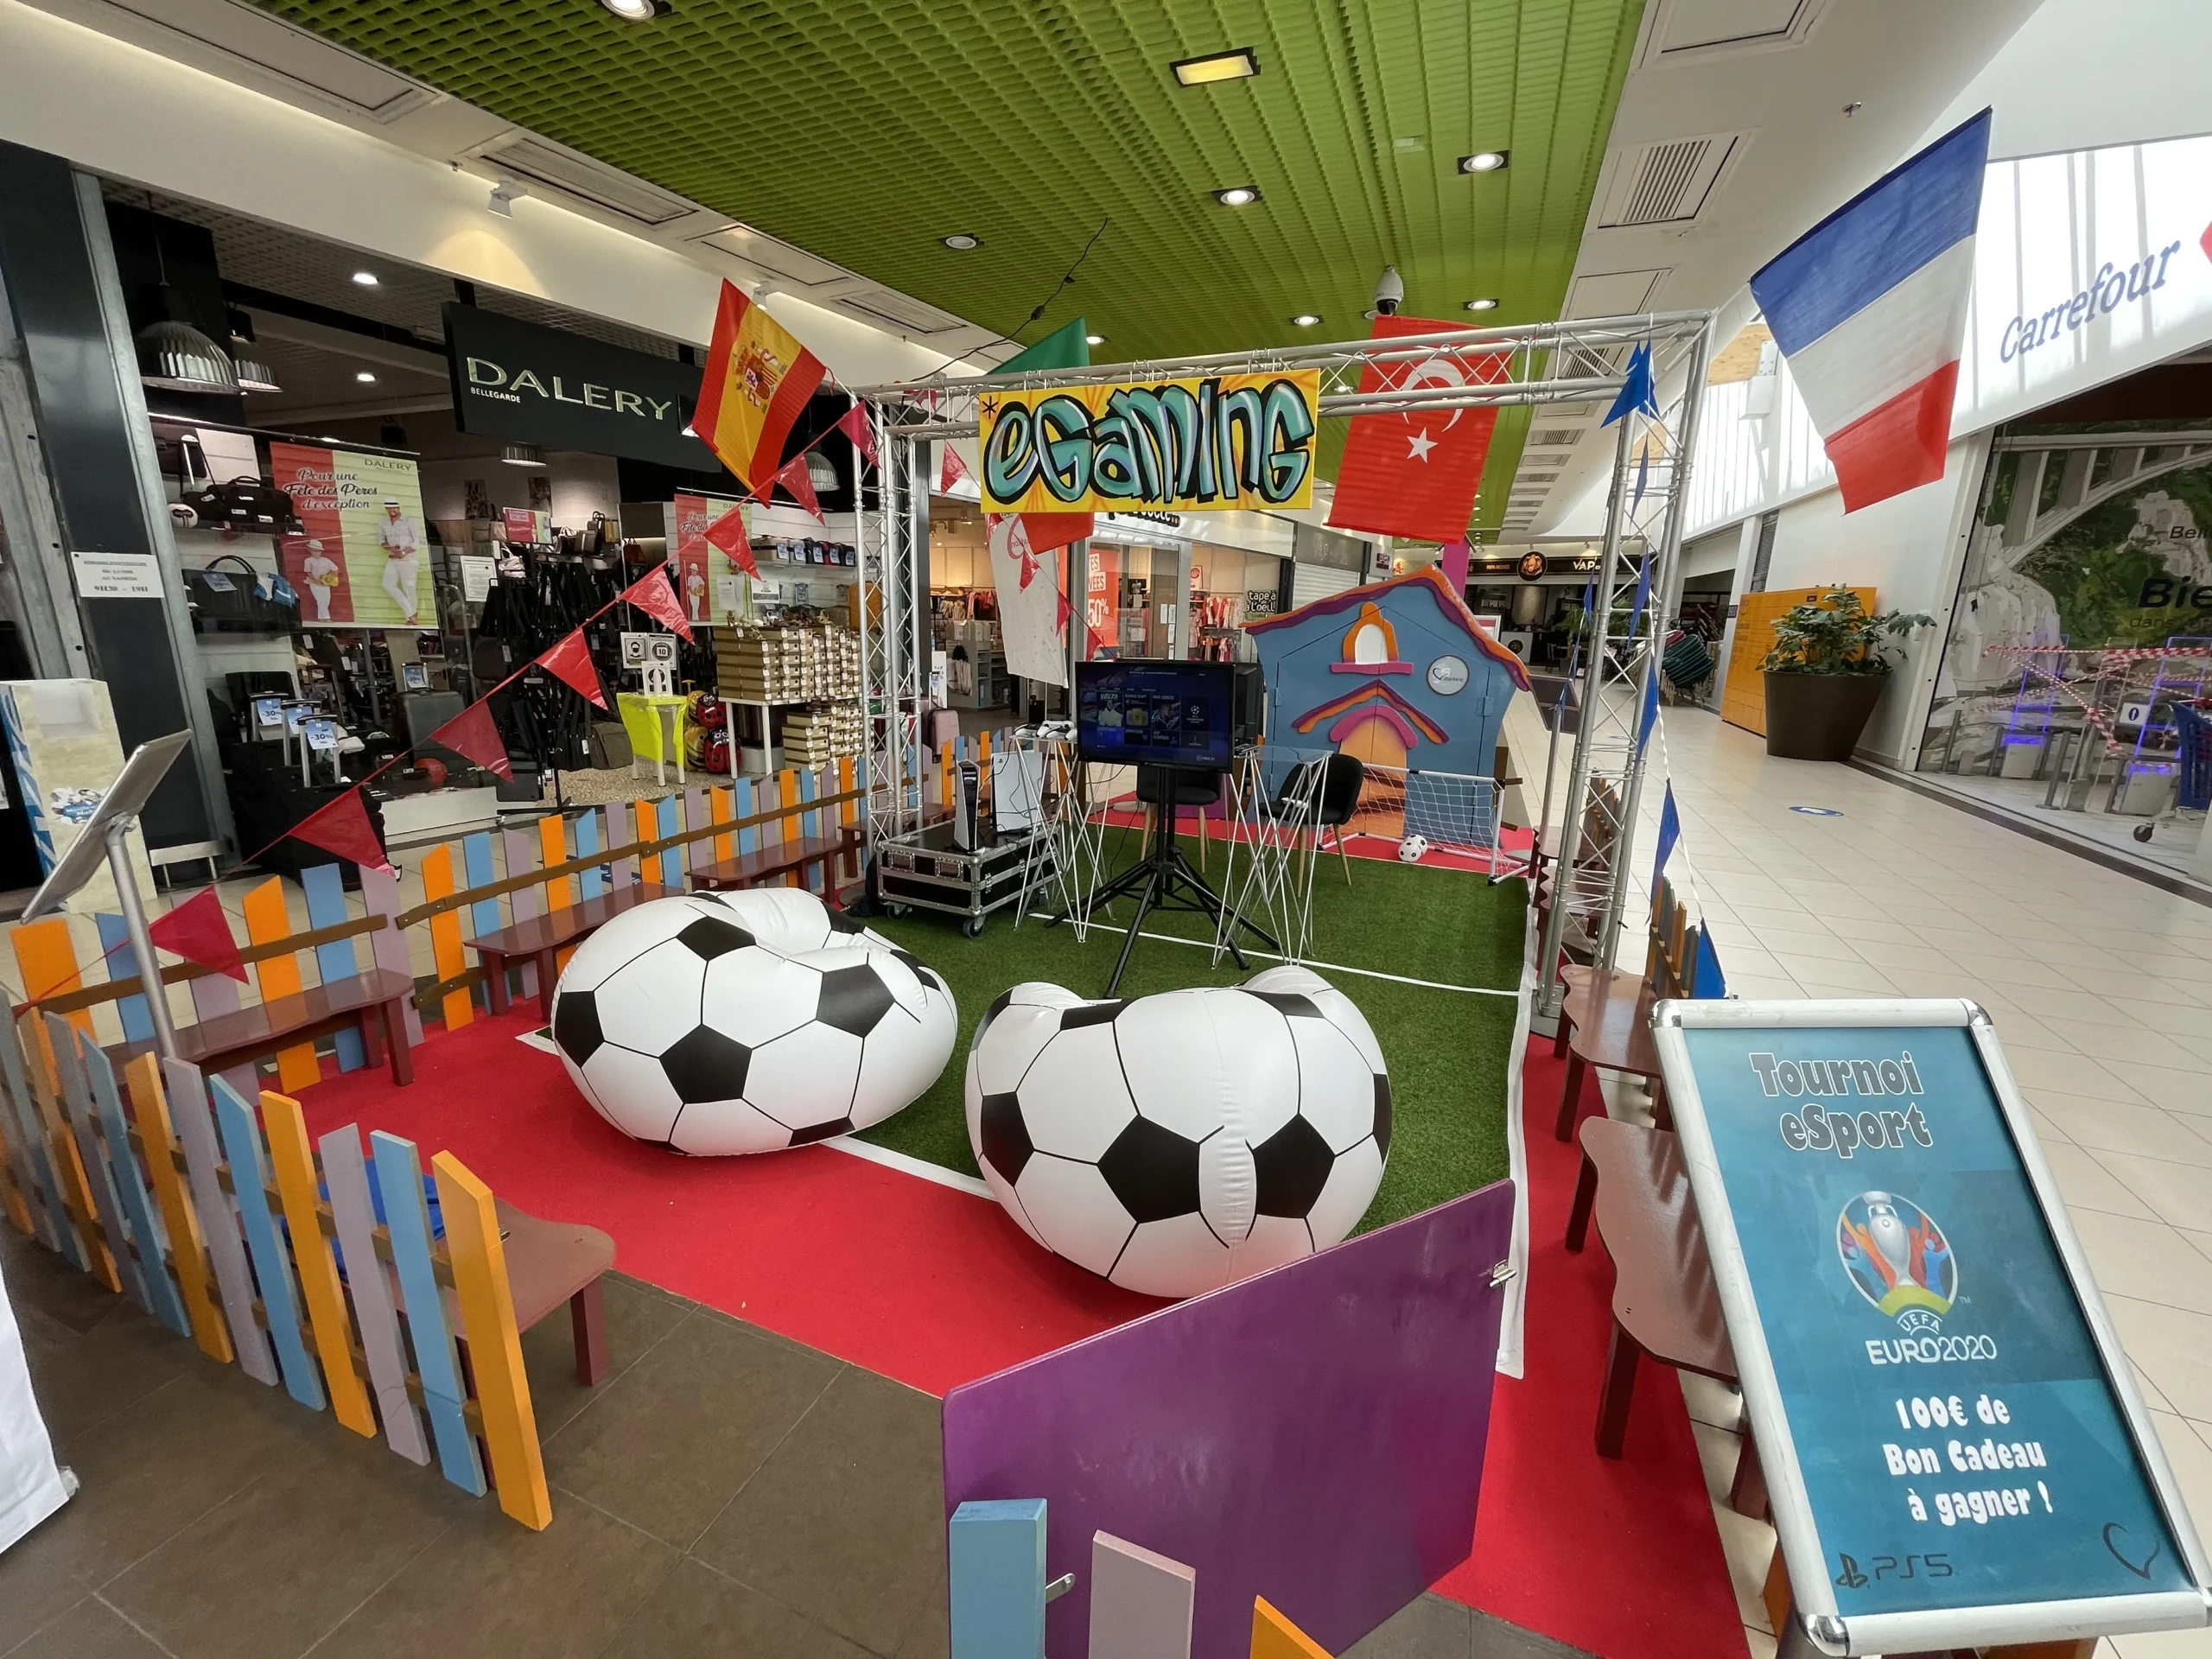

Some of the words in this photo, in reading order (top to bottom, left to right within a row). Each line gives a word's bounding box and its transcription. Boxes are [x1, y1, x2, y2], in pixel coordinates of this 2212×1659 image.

[1999, 239, 2182, 364] Carrefour
[467, 356, 673, 421] DALERY
[470, 386, 522, 404] BELLEGARDE
[297, 467, 335, 482] Pour
[336, 472, 359, 481] une
[364, 458, 412, 472] DALERY
[317, 484, 338, 496] des
[722, 503, 749, 512] DARY
[1748, 1050, 1925, 1097] Tournoi
[1779, 1102, 1934, 1159] eSport
[1899, 1313, 1941, 1332] UEFA
[1895, 1395, 1969, 1430] 100€
[1975, 1394, 2011, 1425] de
[1882, 1443, 1942, 1476] Bon
[1947, 1438, 2048, 1472] Cadeau
[1907, 1487, 1929, 1522] à
[1934, 1487, 2031, 1527] gagner
[1872, 1553, 1954, 1581] PS5
